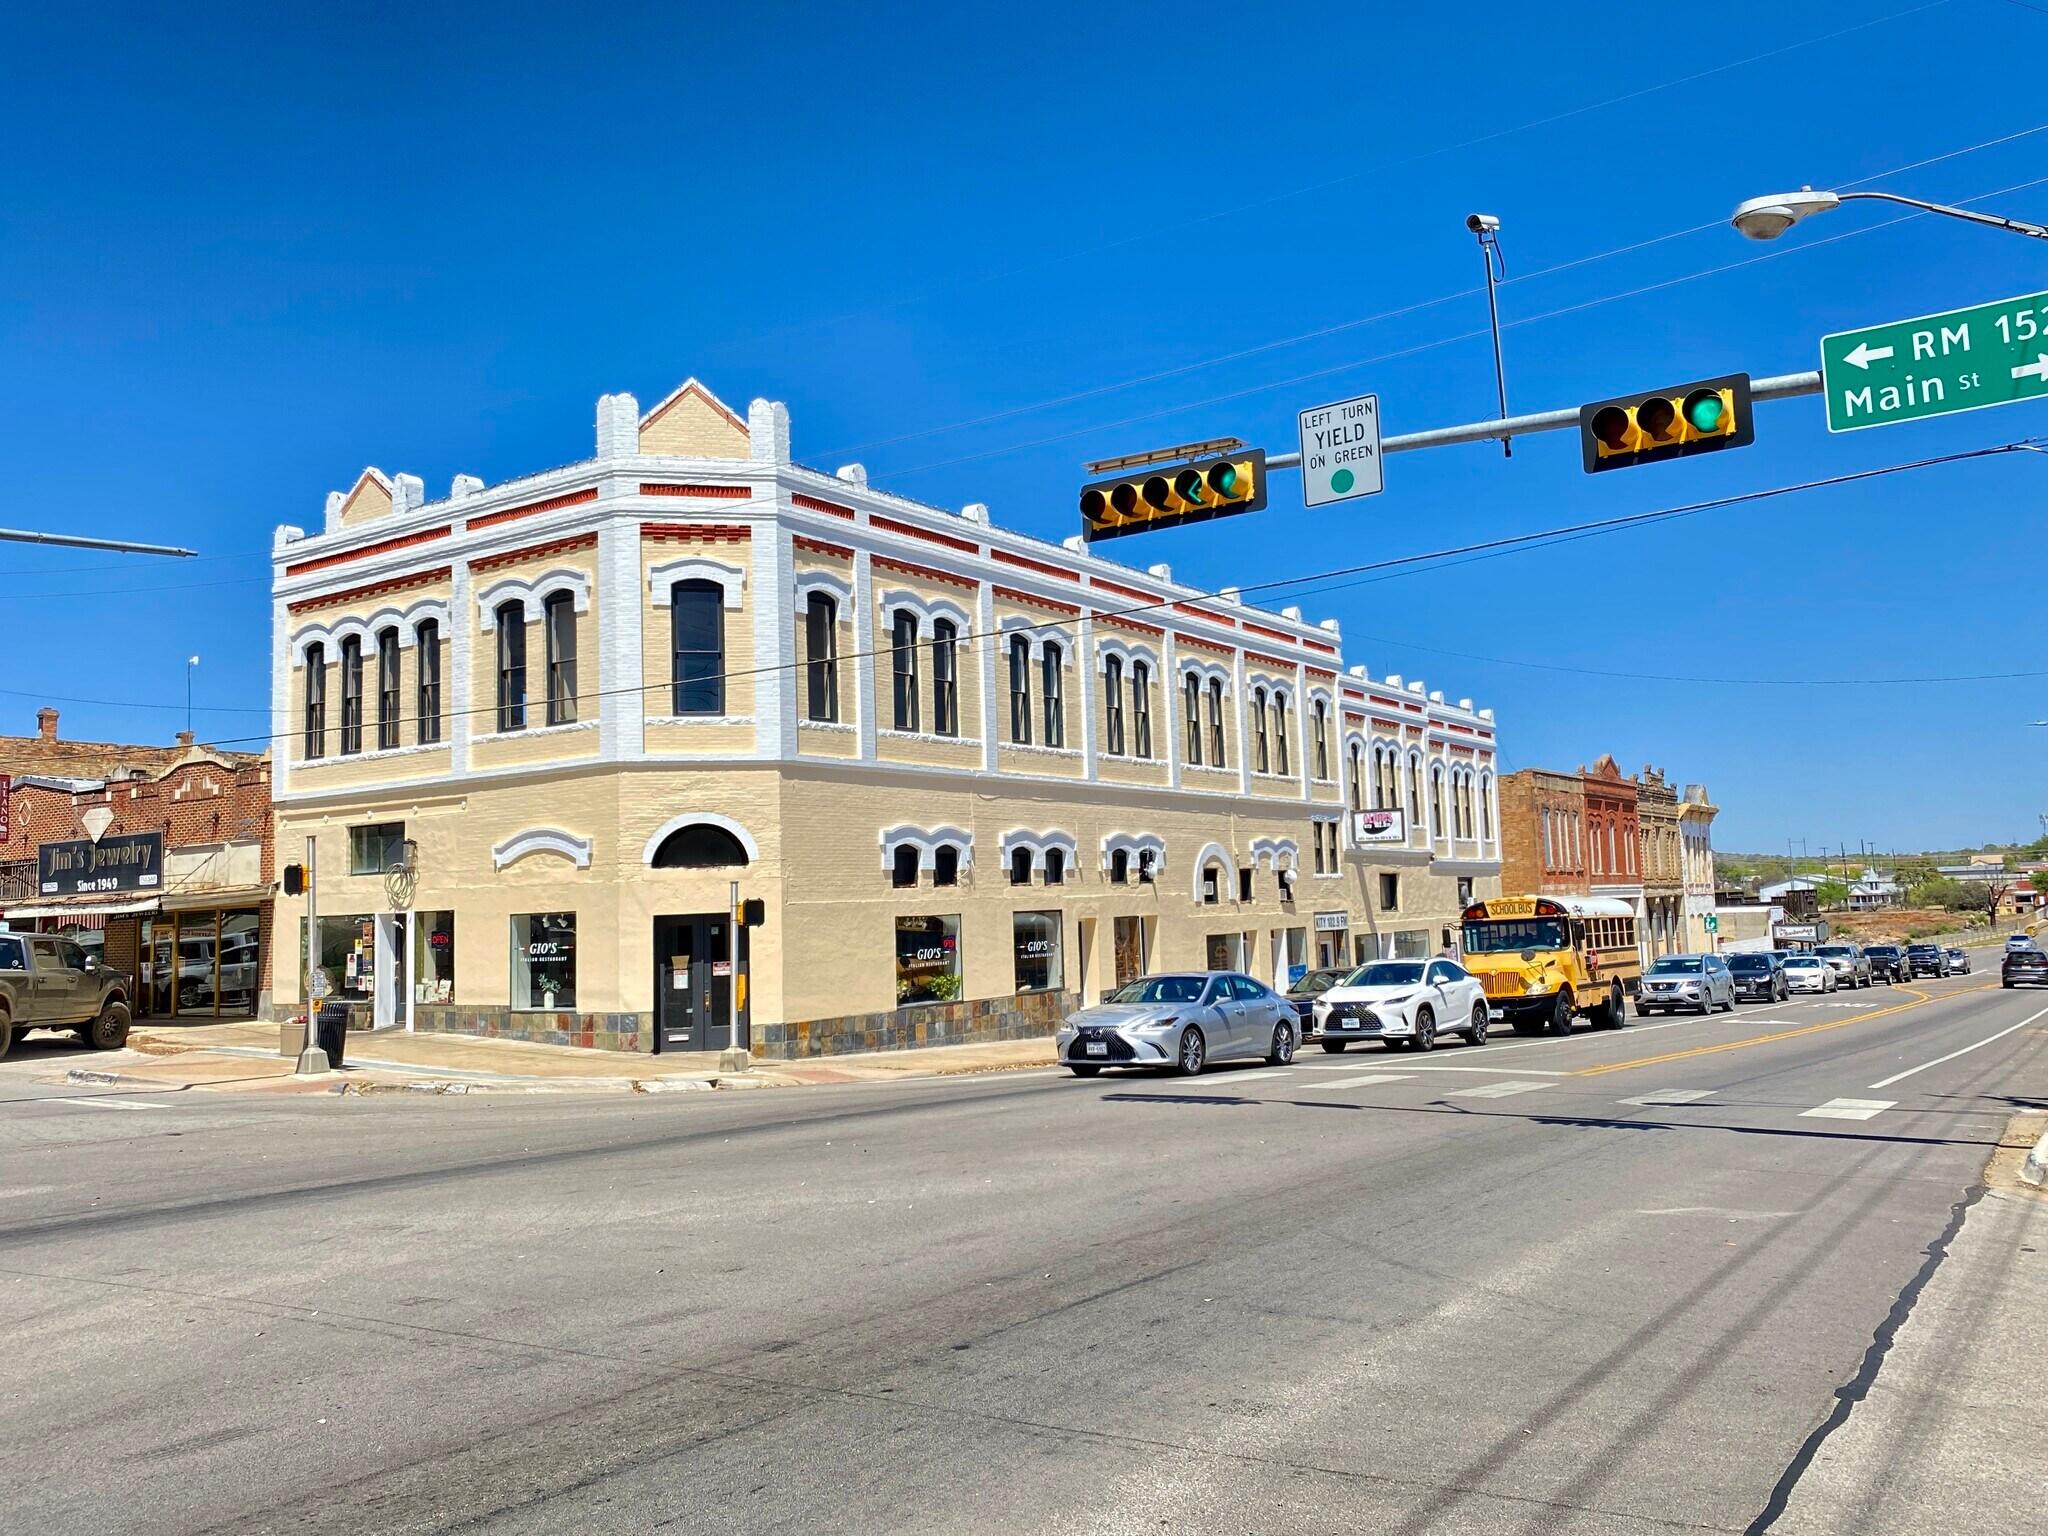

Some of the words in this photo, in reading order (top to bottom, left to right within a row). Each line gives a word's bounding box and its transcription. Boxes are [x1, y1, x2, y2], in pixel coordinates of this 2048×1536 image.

[1912, 322, 1971, 361] RM
[1844, 375, 1945, 418] Main
[1958, 372, 1980, 390] St
[1304, 411, 1332, 429] LEFT
[1341, 402, 1373, 420] TURN
[1315, 423, 1365, 450] YIELD
[1310, 455, 1326, 469] ON
[1334, 444, 1373, 463] GREEN
[0, 781, 8, 824] LLANO
[48, 846, 85, 877] Jim's
[88, 840, 152, 874] Jewelry
[77, 880, 96, 892] Since
[97, 877, 118, 891] 1949
[1491, 903, 1518, 915] SCHOOL
[1518, 903, 1533, 914] BUS
[1327, 916, 1340, 928] 102.9
[432, 935, 449, 944] OPEN
[530, 942, 558, 954] GIO'S
[1027, 940, 1048, 952] GIO'S
[917, 947, 942, 960] GIO'S
